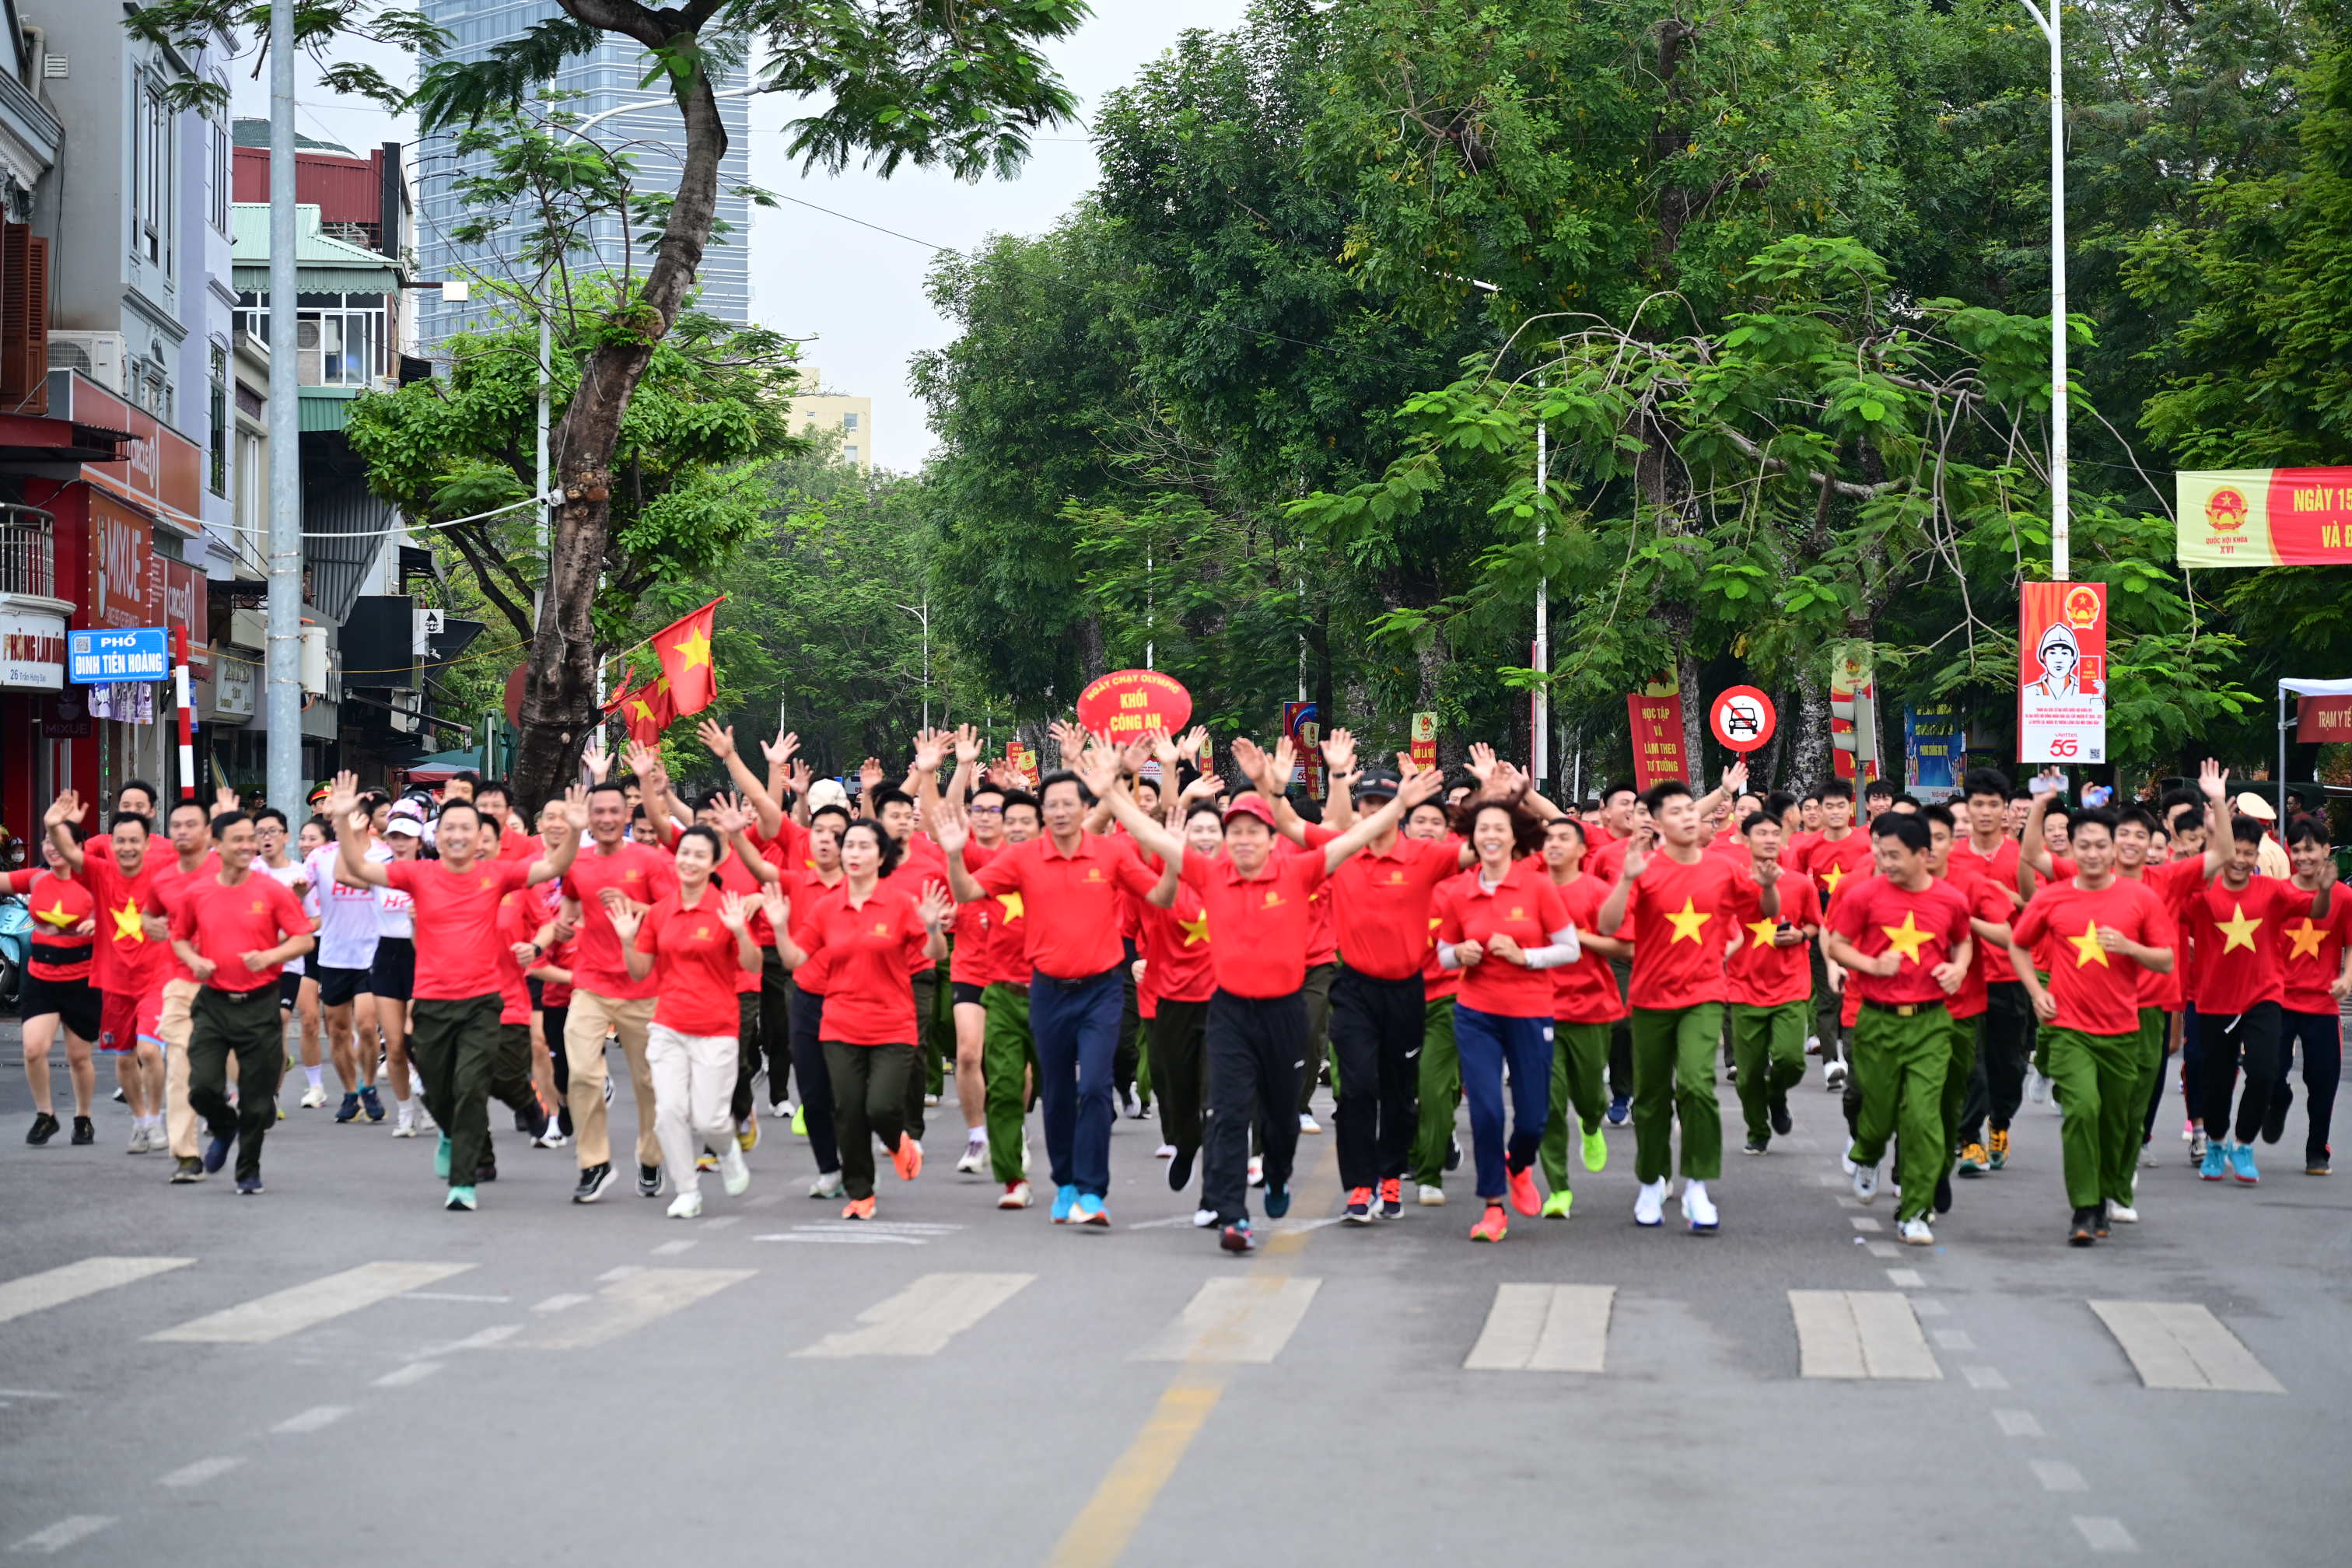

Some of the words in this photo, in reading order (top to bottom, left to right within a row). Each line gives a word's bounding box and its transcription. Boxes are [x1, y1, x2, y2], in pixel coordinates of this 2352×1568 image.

[2294, 484, 2333, 511] NGÀY
[2322, 520, 2341, 548] VÀ
[107, 516, 142, 602] MIXUE
[168, 586, 185, 619] CIRCLE
[101, 632, 137, 647] PHỐ
[75, 655, 100, 675] ĐINH
[102, 650, 126, 674] TIÊN
[128, 649, 163, 673] HOÀNG
[10, 669, 19, 681] 26
[1119, 687, 1148, 709] KHỐI
[1110, 712, 1143, 732] CÔNG
[1144, 712, 1161, 730] AN
[1641, 708, 1657, 722] HỌC
[1657, 706, 1670, 722] TẬP
[2319, 710, 2336, 731] TRẠM
[2338, 711, 2343, 727] Y
[1654, 723, 1663, 737] VÀ
[1643, 740, 1659, 754] LÀM
[1660, 743, 1677, 754] THEO
[2049, 739, 2078, 757] 5G
